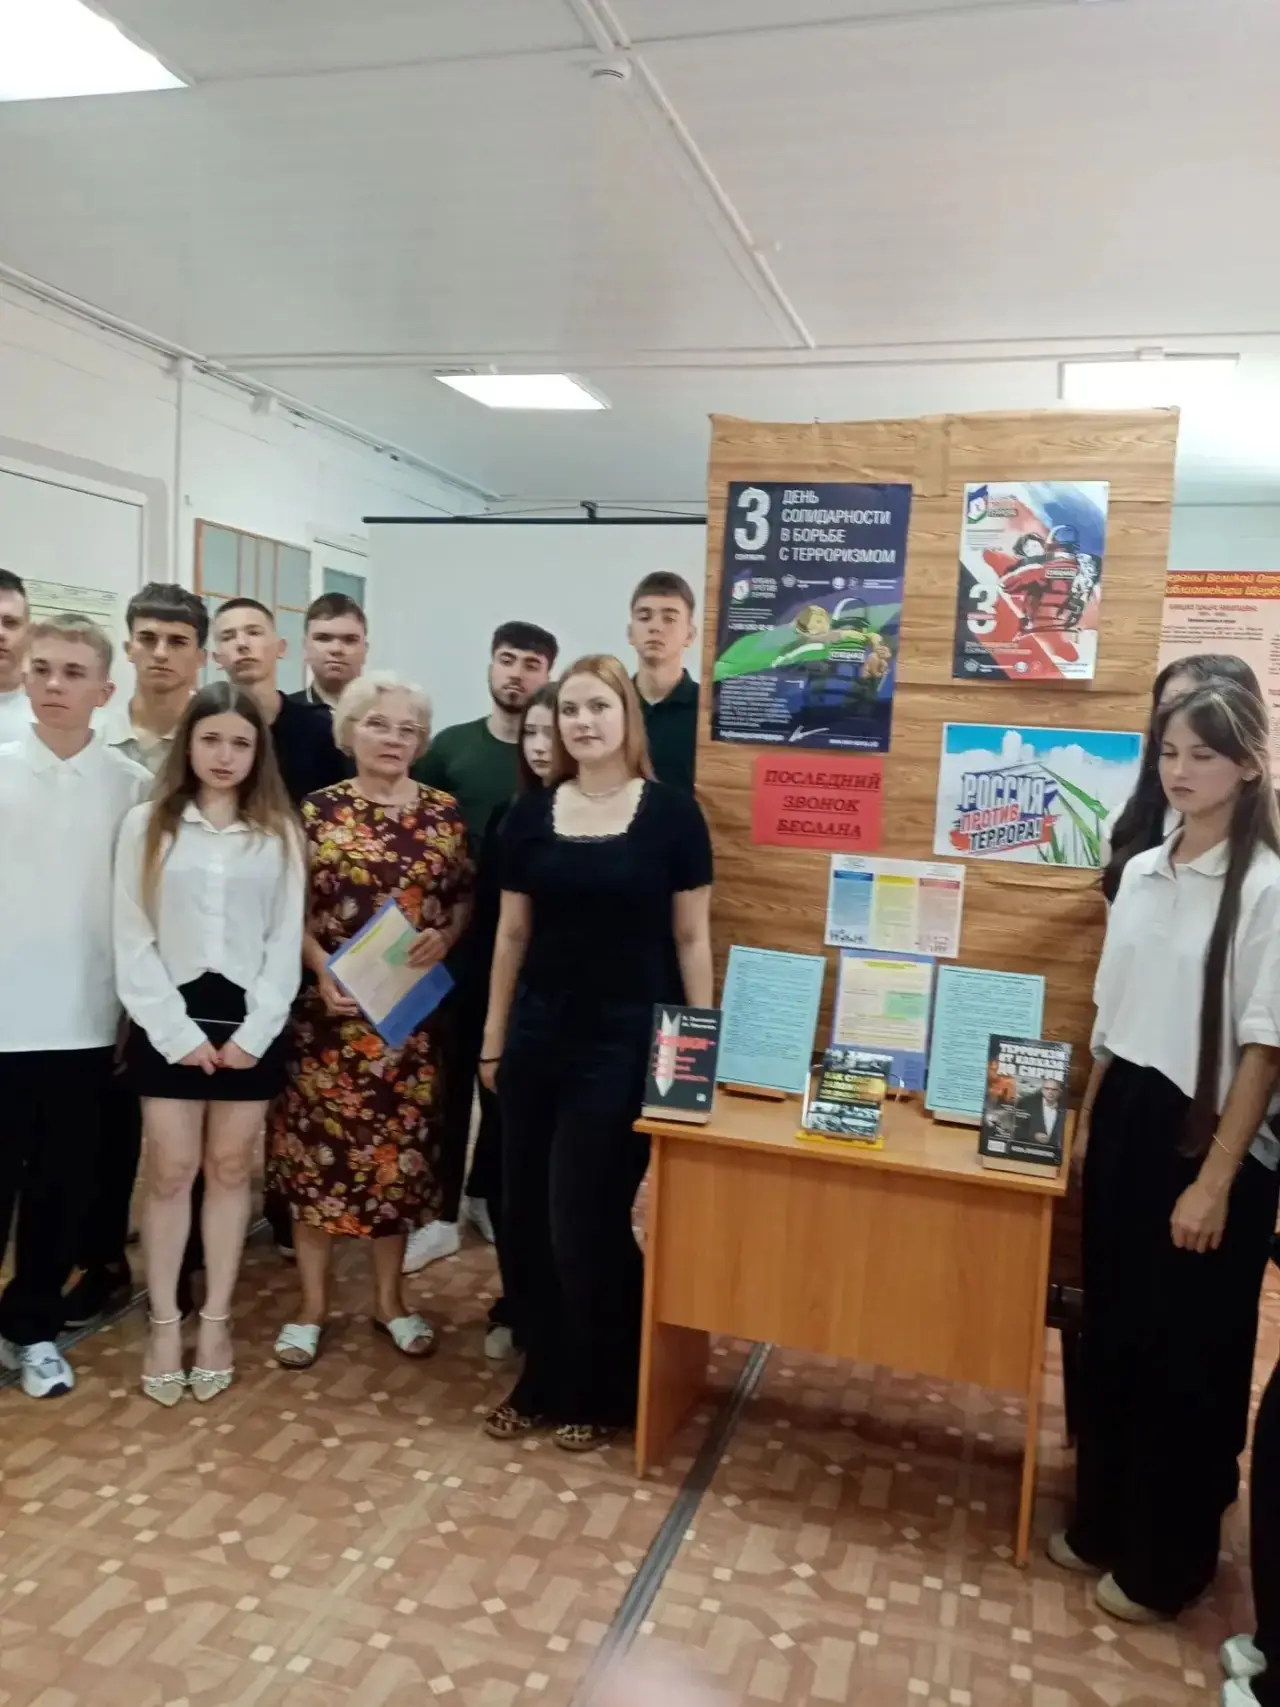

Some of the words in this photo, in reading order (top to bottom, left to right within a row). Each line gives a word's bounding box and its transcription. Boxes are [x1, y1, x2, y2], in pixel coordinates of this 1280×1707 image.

[782, 490, 820, 505] ДЕНЬ
[733, 487, 771, 551] 3
[781, 508, 892, 525] СОЛИДАРНОСТИ
[780, 528, 791, 542] В
[793, 528, 847, 543] БОРЬБЕ
[779, 547, 789, 561] С
[791, 548, 897, 564] ТЕРРОРИЗМОМ
[1165, 574, 1205, 583] ераны
[966, 584, 999, 634] 3
[764, 769, 882, 791] ПОСЛЕДНИЙ
[962, 772, 1046, 815] РОССИЯ
[782, 795, 860, 813] ЗВОНОК
[959, 804, 1021, 833] ПРОТИВ
[776, 819, 862, 838] БЕСЛАНА
[968, 819, 1042, 851] ТЕРРОРА!
